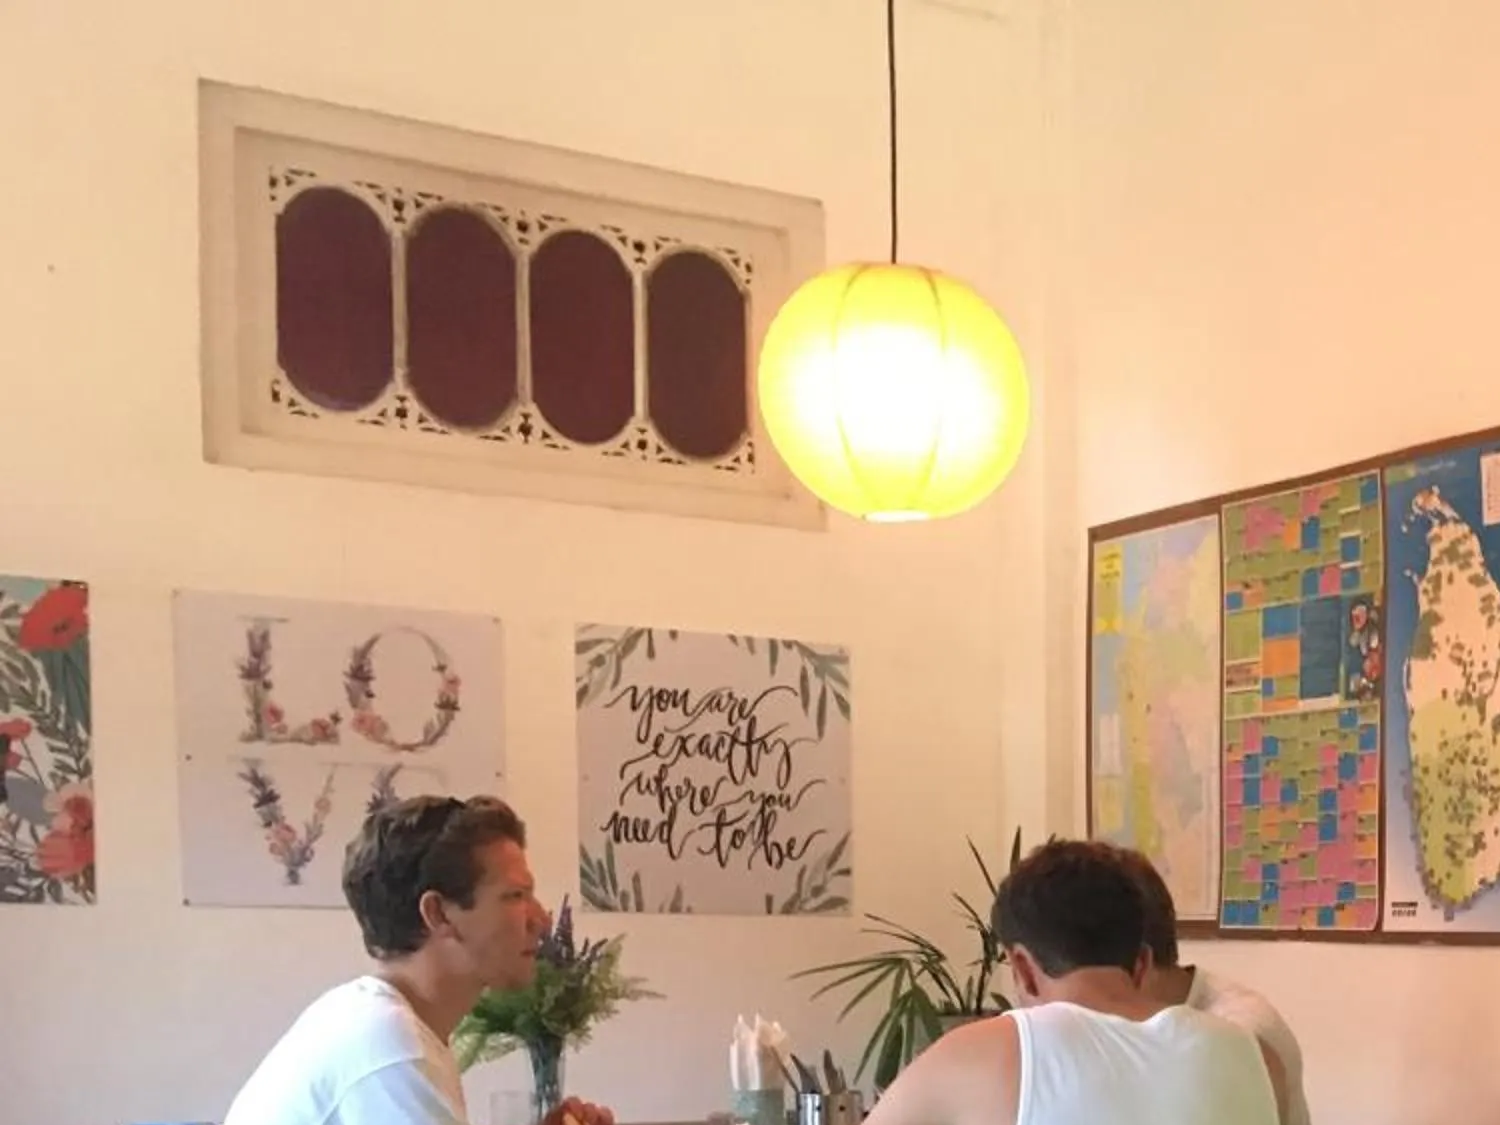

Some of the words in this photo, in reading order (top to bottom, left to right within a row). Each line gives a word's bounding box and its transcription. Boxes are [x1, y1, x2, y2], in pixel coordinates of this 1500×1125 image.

[605, 684, 700, 743] you
[688, 686, 798, 728] are
[621, 717, 822, 788] exactly
[620, 763, 727, 816] where
[601, 810, 699, 860] need
[698, 808, 752, 868] to
[748, 807, 827, 870] be
